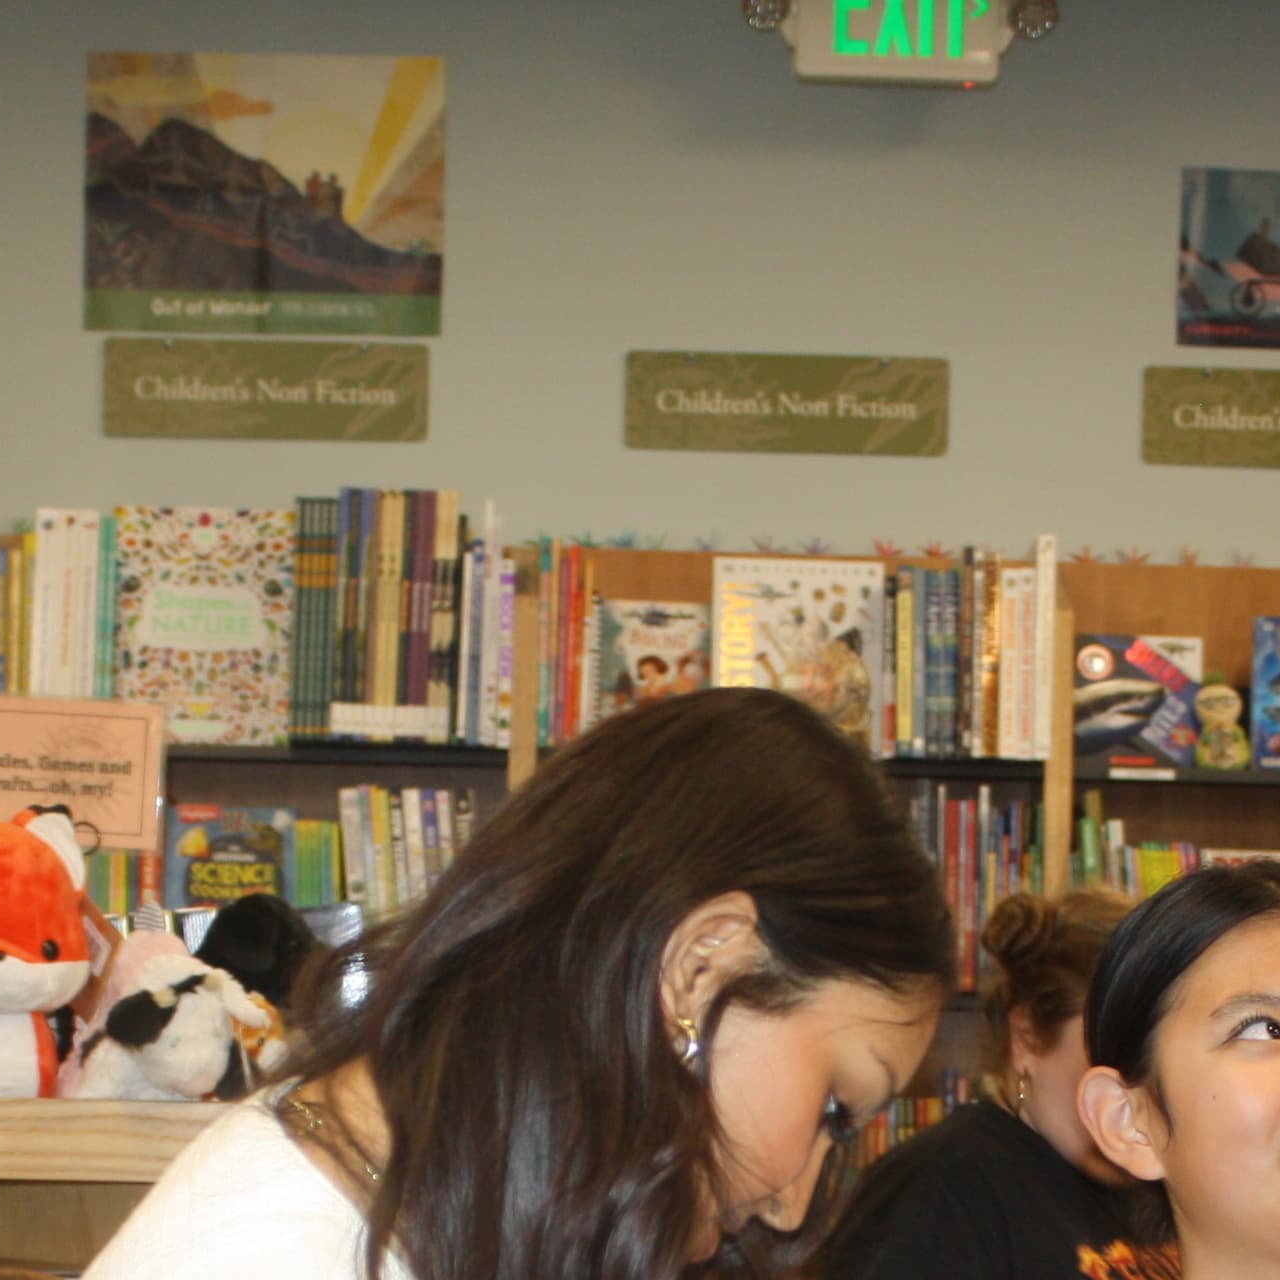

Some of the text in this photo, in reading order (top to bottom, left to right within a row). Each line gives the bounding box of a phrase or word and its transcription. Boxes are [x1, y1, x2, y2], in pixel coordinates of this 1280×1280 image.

[133, 375, 398, 405] Children's Non Fiction
[656, 388, 919, 419] Children's Non Fiction
[37, 755, 95, 774] Games
[98, 759, 133, 776] and
[80, 780, 114, 799] my!
[190, 862, 276, 885] SCIENCE
